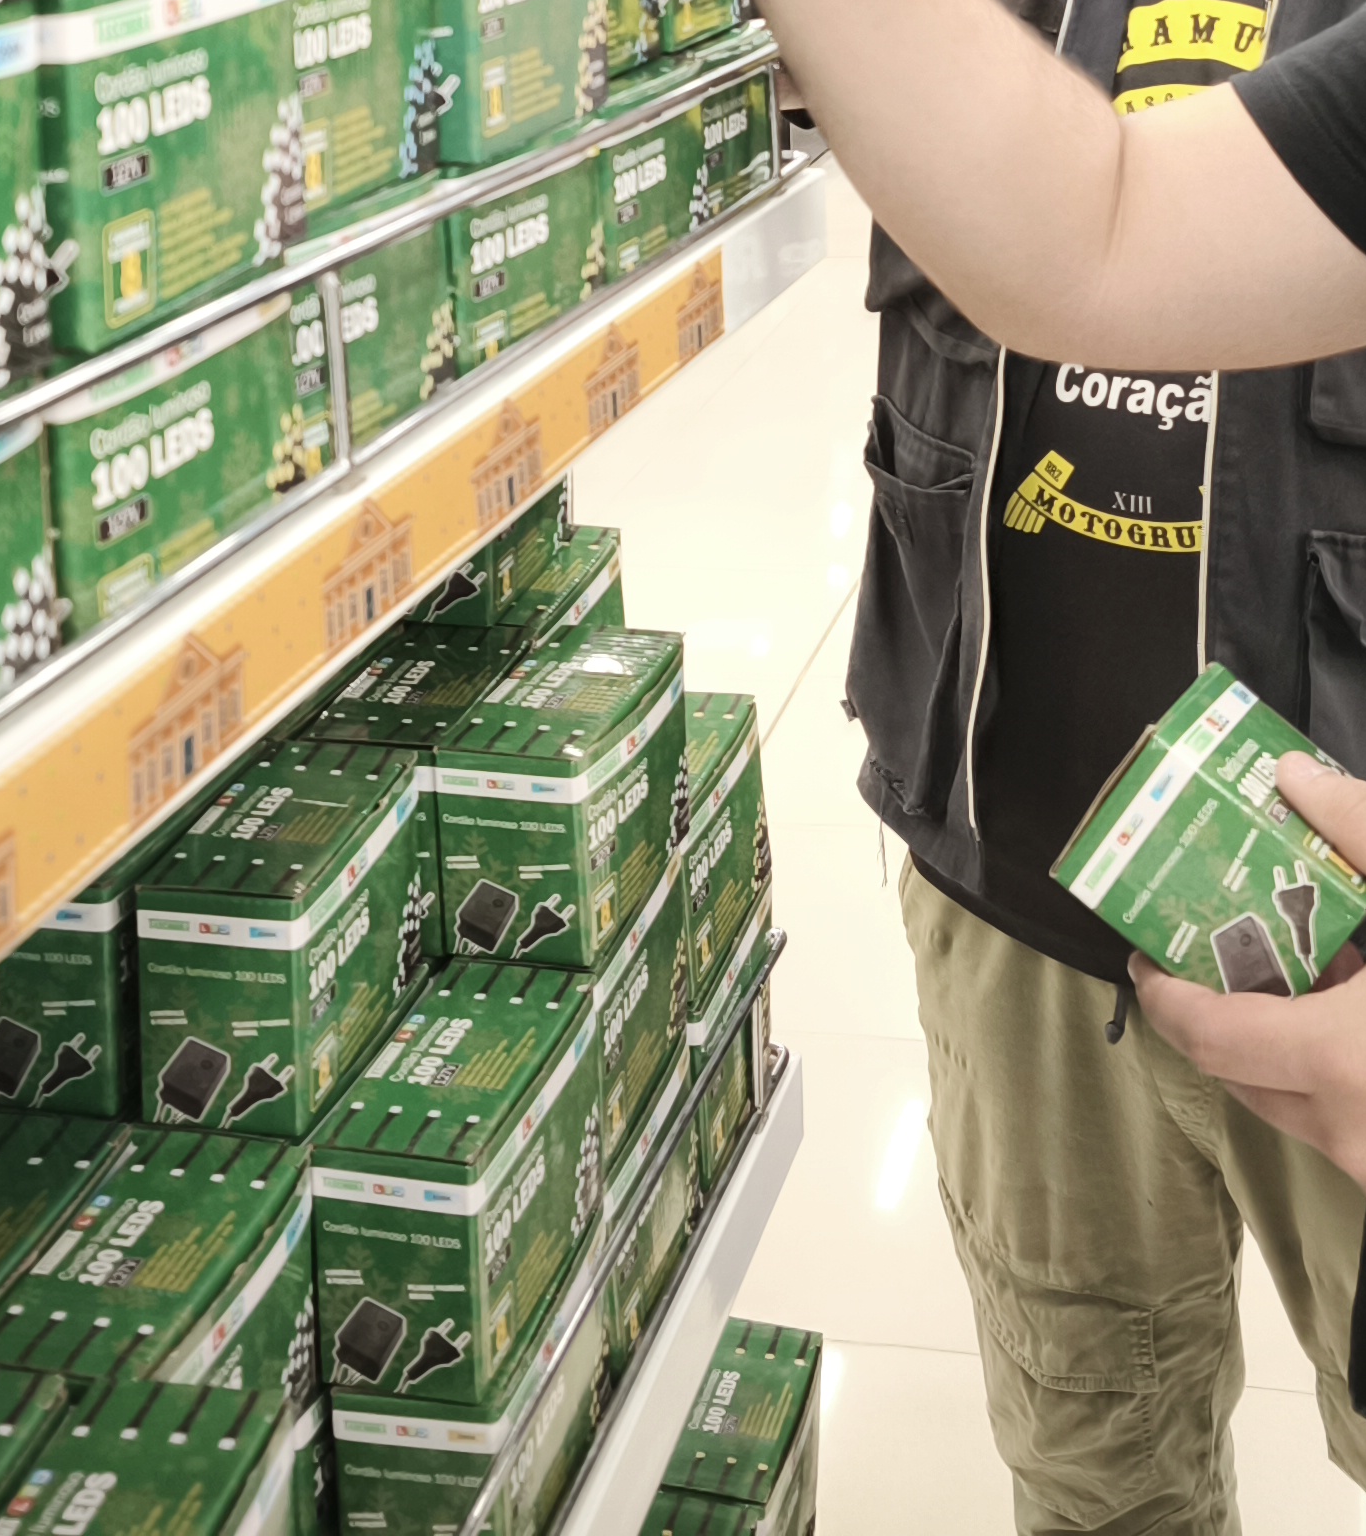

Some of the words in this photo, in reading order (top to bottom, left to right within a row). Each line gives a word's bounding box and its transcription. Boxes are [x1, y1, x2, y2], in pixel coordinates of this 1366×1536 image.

[292, 27, 327, 70] 100
[328, 12, 372, 61] LEDS
[96, 97, 151, 156] 100
[149, 74, 213, 137] LEDS
[613, 166, 638, 205] 100
[637, 153, 667, 193] LEDS
[470, 234, 505, 275] 100
[504, 212, 550, 260] LEDS
[1055, 363, 1212, 431] Coraçã
[91, 443, 150, 511] 100
[149, 406, 215, 481] LEDS
[1031, 485, 1203, 549] MOTOGRU
[1111, 491, 1152, 515] XIII
[382, 684, 413, 705] 100
[399, 660, 436, 686] LEDS
[520, 687, 554, 710] 100
[230, 816, 265, 841] 100
[250, 785, 294, 818] LEDS
[588, 807, 617, 852] 100
[618, 773, 650, 825] LEDS
[689, 855, 709, 897] 100
[708, 820, 733, 869] LEDS
[234, 969, 256, 982] 100
[256, 972, 287, 985] LEDS
[308, 949, 337, 1001] 100
[337, 906, 371, 967] LEDS
[602, 1009, 624, 1057] 100
[623, 964, 650, 1021] LEDS
[406, 1055, 444, 1086] 100
[428, 1017, 474, 1057] LEDS
[410, 1233, 431, 1246] 100
[432, 1234, 462, 1250] LEDS
[485, 1208, 512, 1266] 100
[512, 1154, 546, 1224] LEDS
[77, 1248, 124, 1288] 100
[108, 1199, 166, 1248] LEDS
[712, 1369, 741, 1409] LEDS
[701, 1407, 726, 1437] 100
[52, 1471, 118, 1536] LEDS
